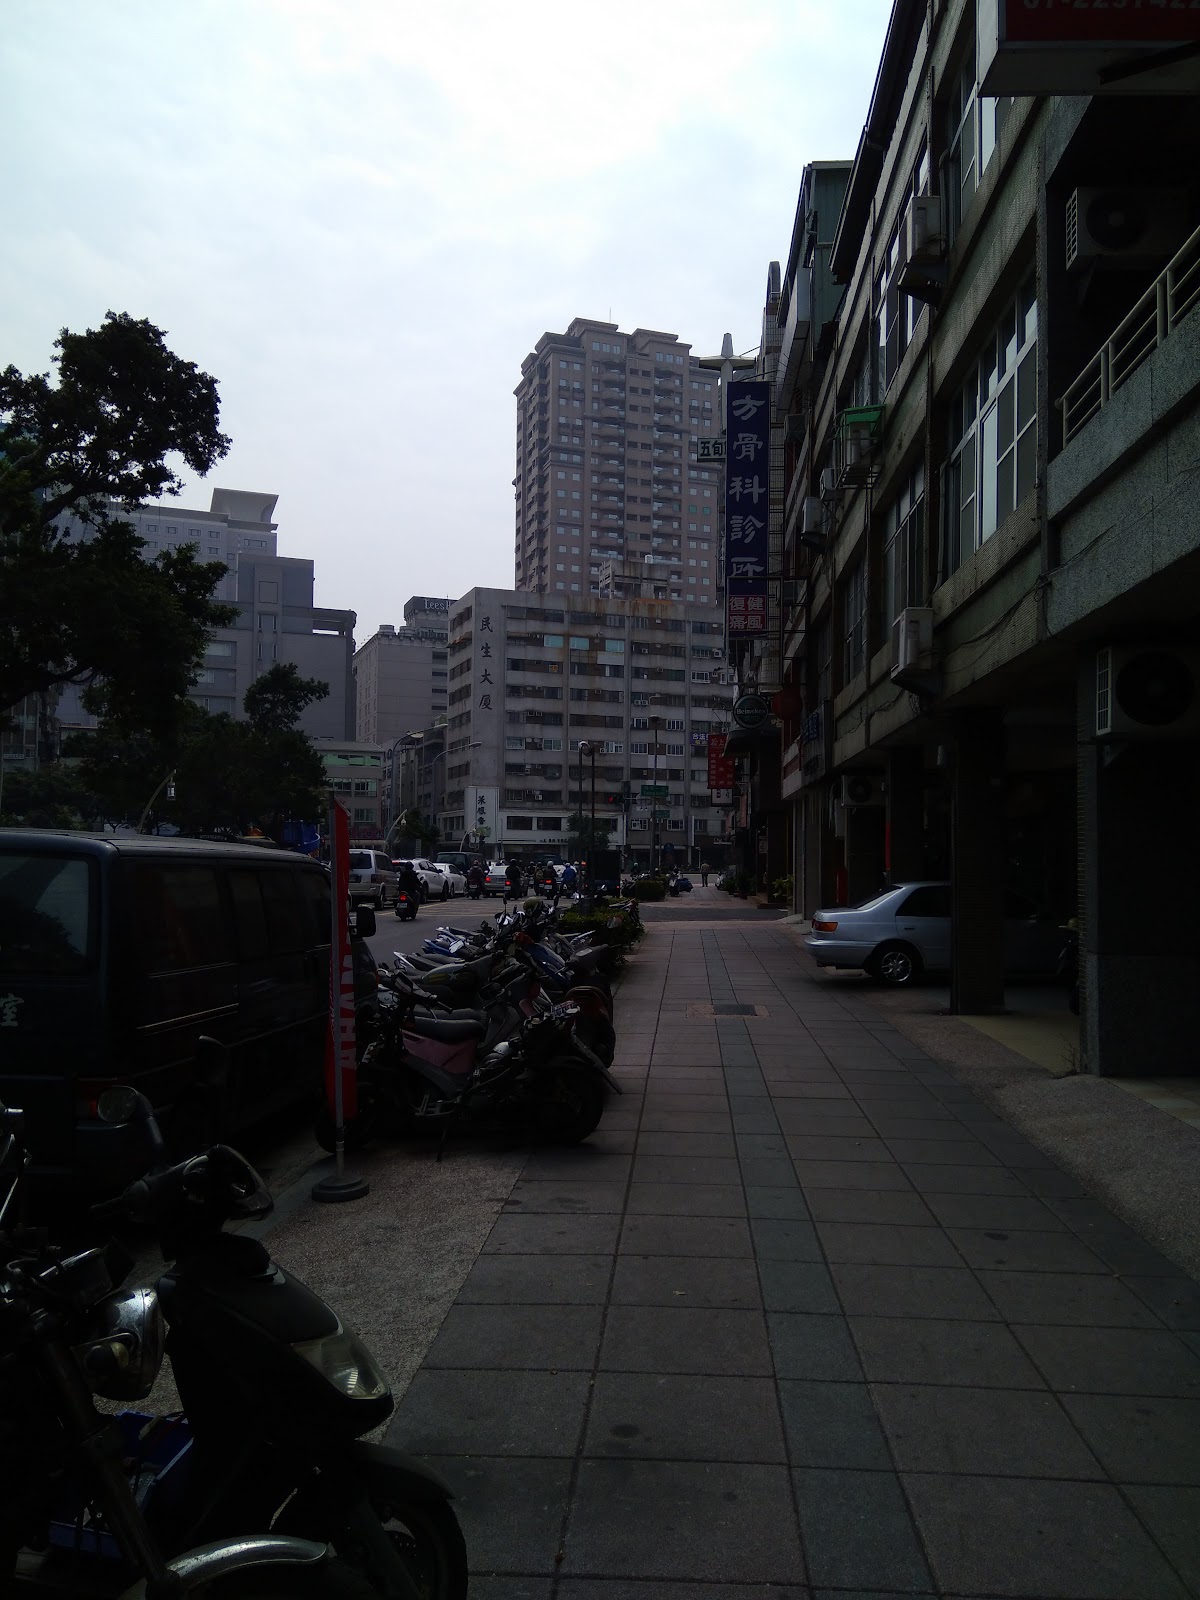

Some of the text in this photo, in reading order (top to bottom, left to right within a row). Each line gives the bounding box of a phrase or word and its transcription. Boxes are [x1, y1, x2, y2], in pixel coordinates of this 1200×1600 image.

[728, 394, 766, 584] 方骨科診所
[729, 596, 763, 612] 復健
